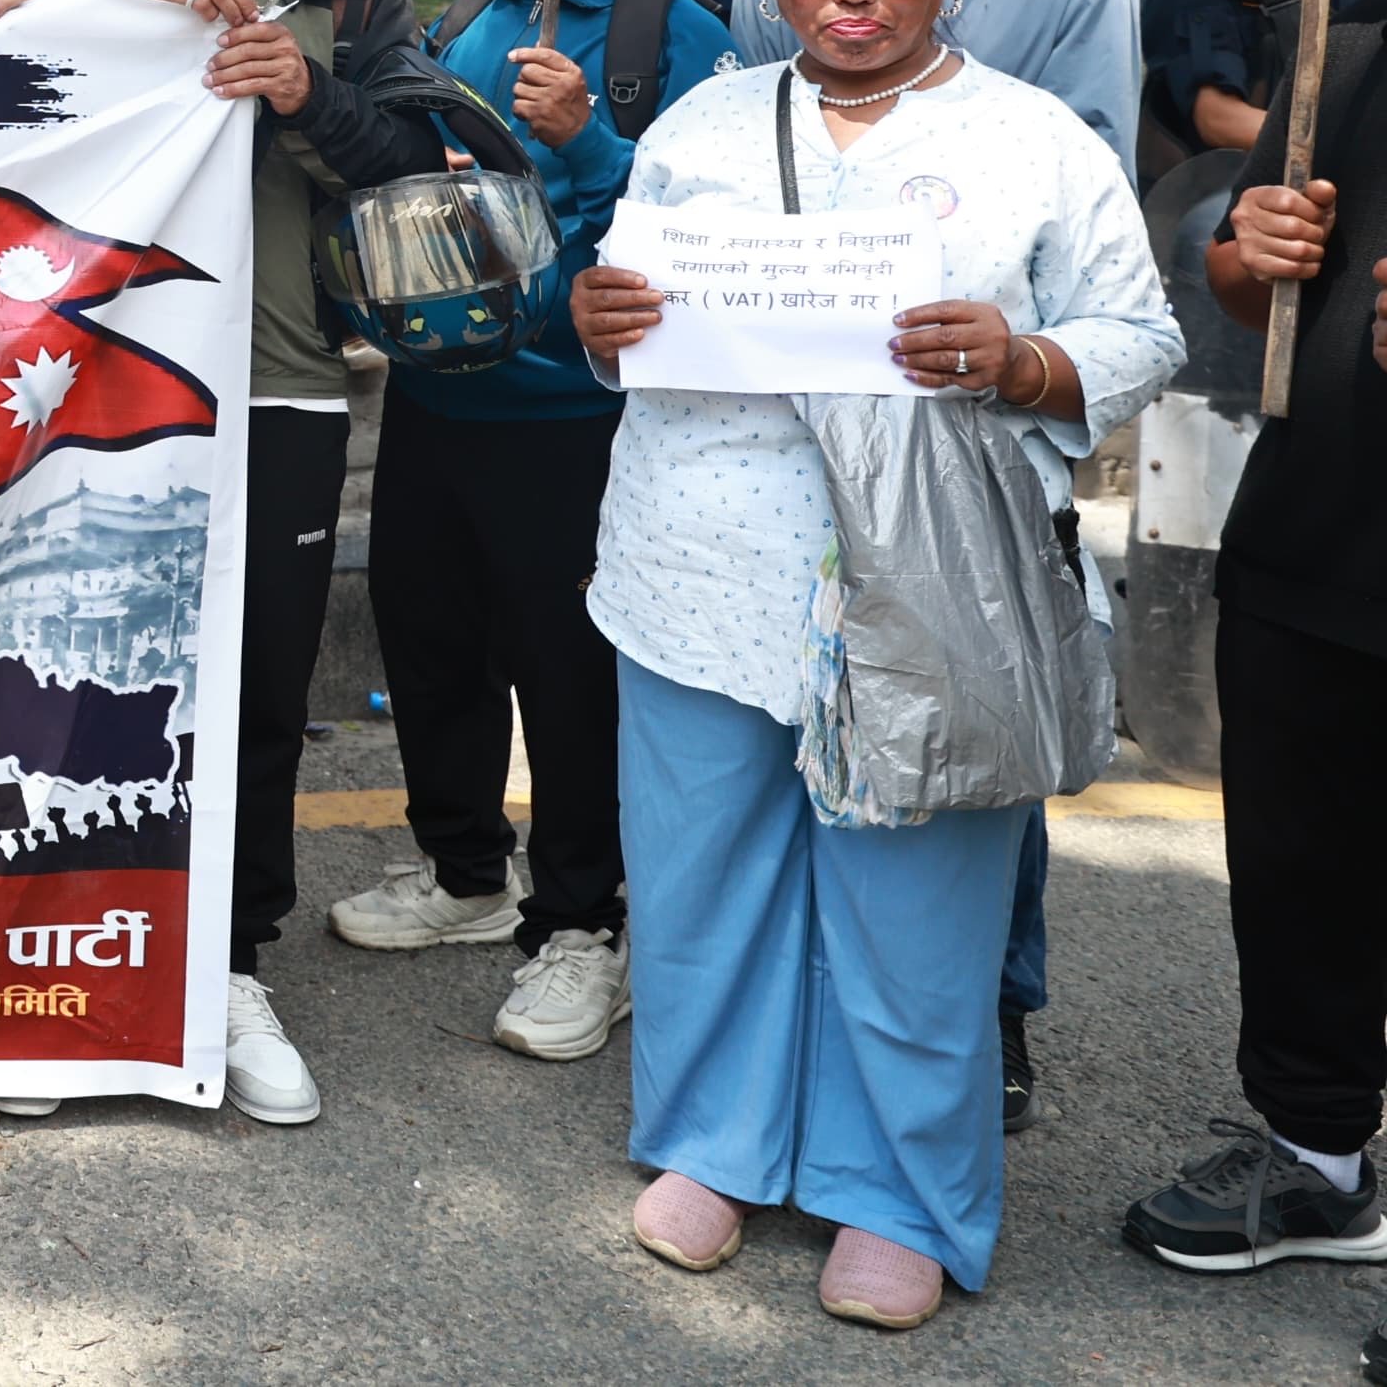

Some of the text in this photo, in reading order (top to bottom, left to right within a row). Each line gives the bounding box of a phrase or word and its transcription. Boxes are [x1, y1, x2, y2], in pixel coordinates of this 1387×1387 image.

[662, 228, 913, 254] शिक्षा र विद्युतमा
[671, 258, 811, 282] लगाएको मुल्य
[664, 289, 692, 309] कर
[780, 287, 837, 310] खारेज
[850, 293, 878, 311] गर
[5, 908, 153, 969] पार्टी
